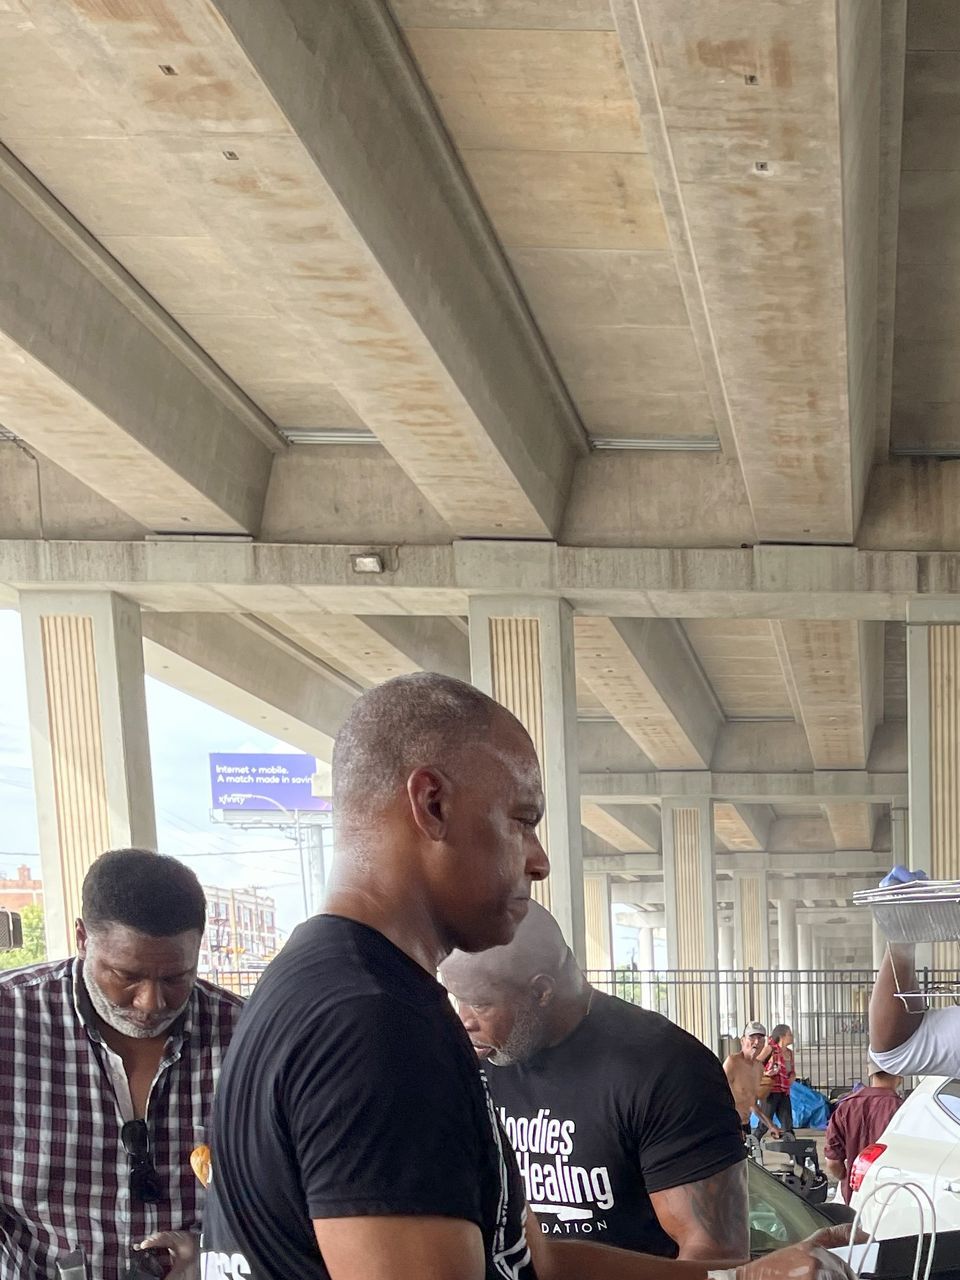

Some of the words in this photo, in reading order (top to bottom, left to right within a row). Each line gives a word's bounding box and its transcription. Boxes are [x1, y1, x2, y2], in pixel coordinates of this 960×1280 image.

[216, 765, 250, 774] Internet
[217, 774, 225, 783] A
[226, 775, 255, 784] match
[256, 775, 280, 784] made
[281, 775, 290, 783] in
[291, 775, 312, 784] savin
